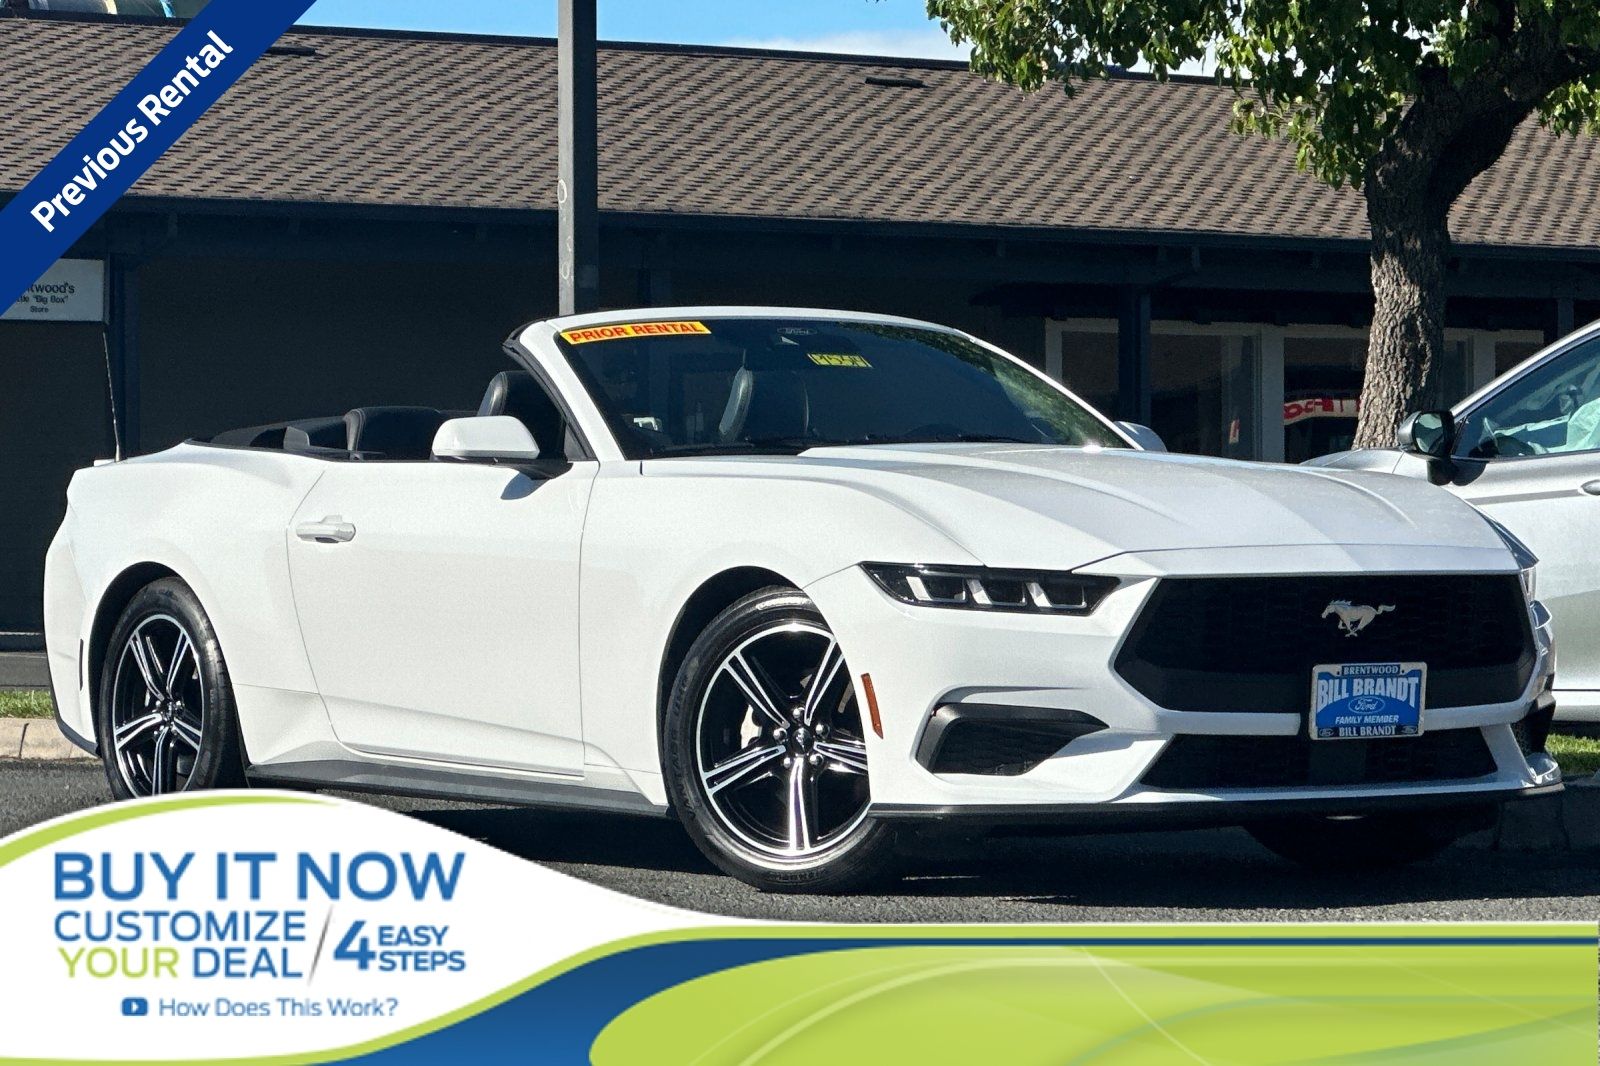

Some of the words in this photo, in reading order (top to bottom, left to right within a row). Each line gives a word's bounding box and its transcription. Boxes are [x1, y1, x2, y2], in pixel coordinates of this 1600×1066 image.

[569, 327, 627, 342] PRIOR
[631, 323, 704, 335] RENTAL
[1343, 665, 1399, 676] BRENTWOOD
[1317, 678, 1349, 714] BILL
[1352, 676, 1419, 709] BRANDT
[1354, 699, 1378, 711] Ford
[1335, 715, 1361, 725] FAMILY
[1363, 714, 1399, 724] MEMBER
[1339, 726, 1359, 737] BILL
[1360, 725, 1397, 736] BRANDT
